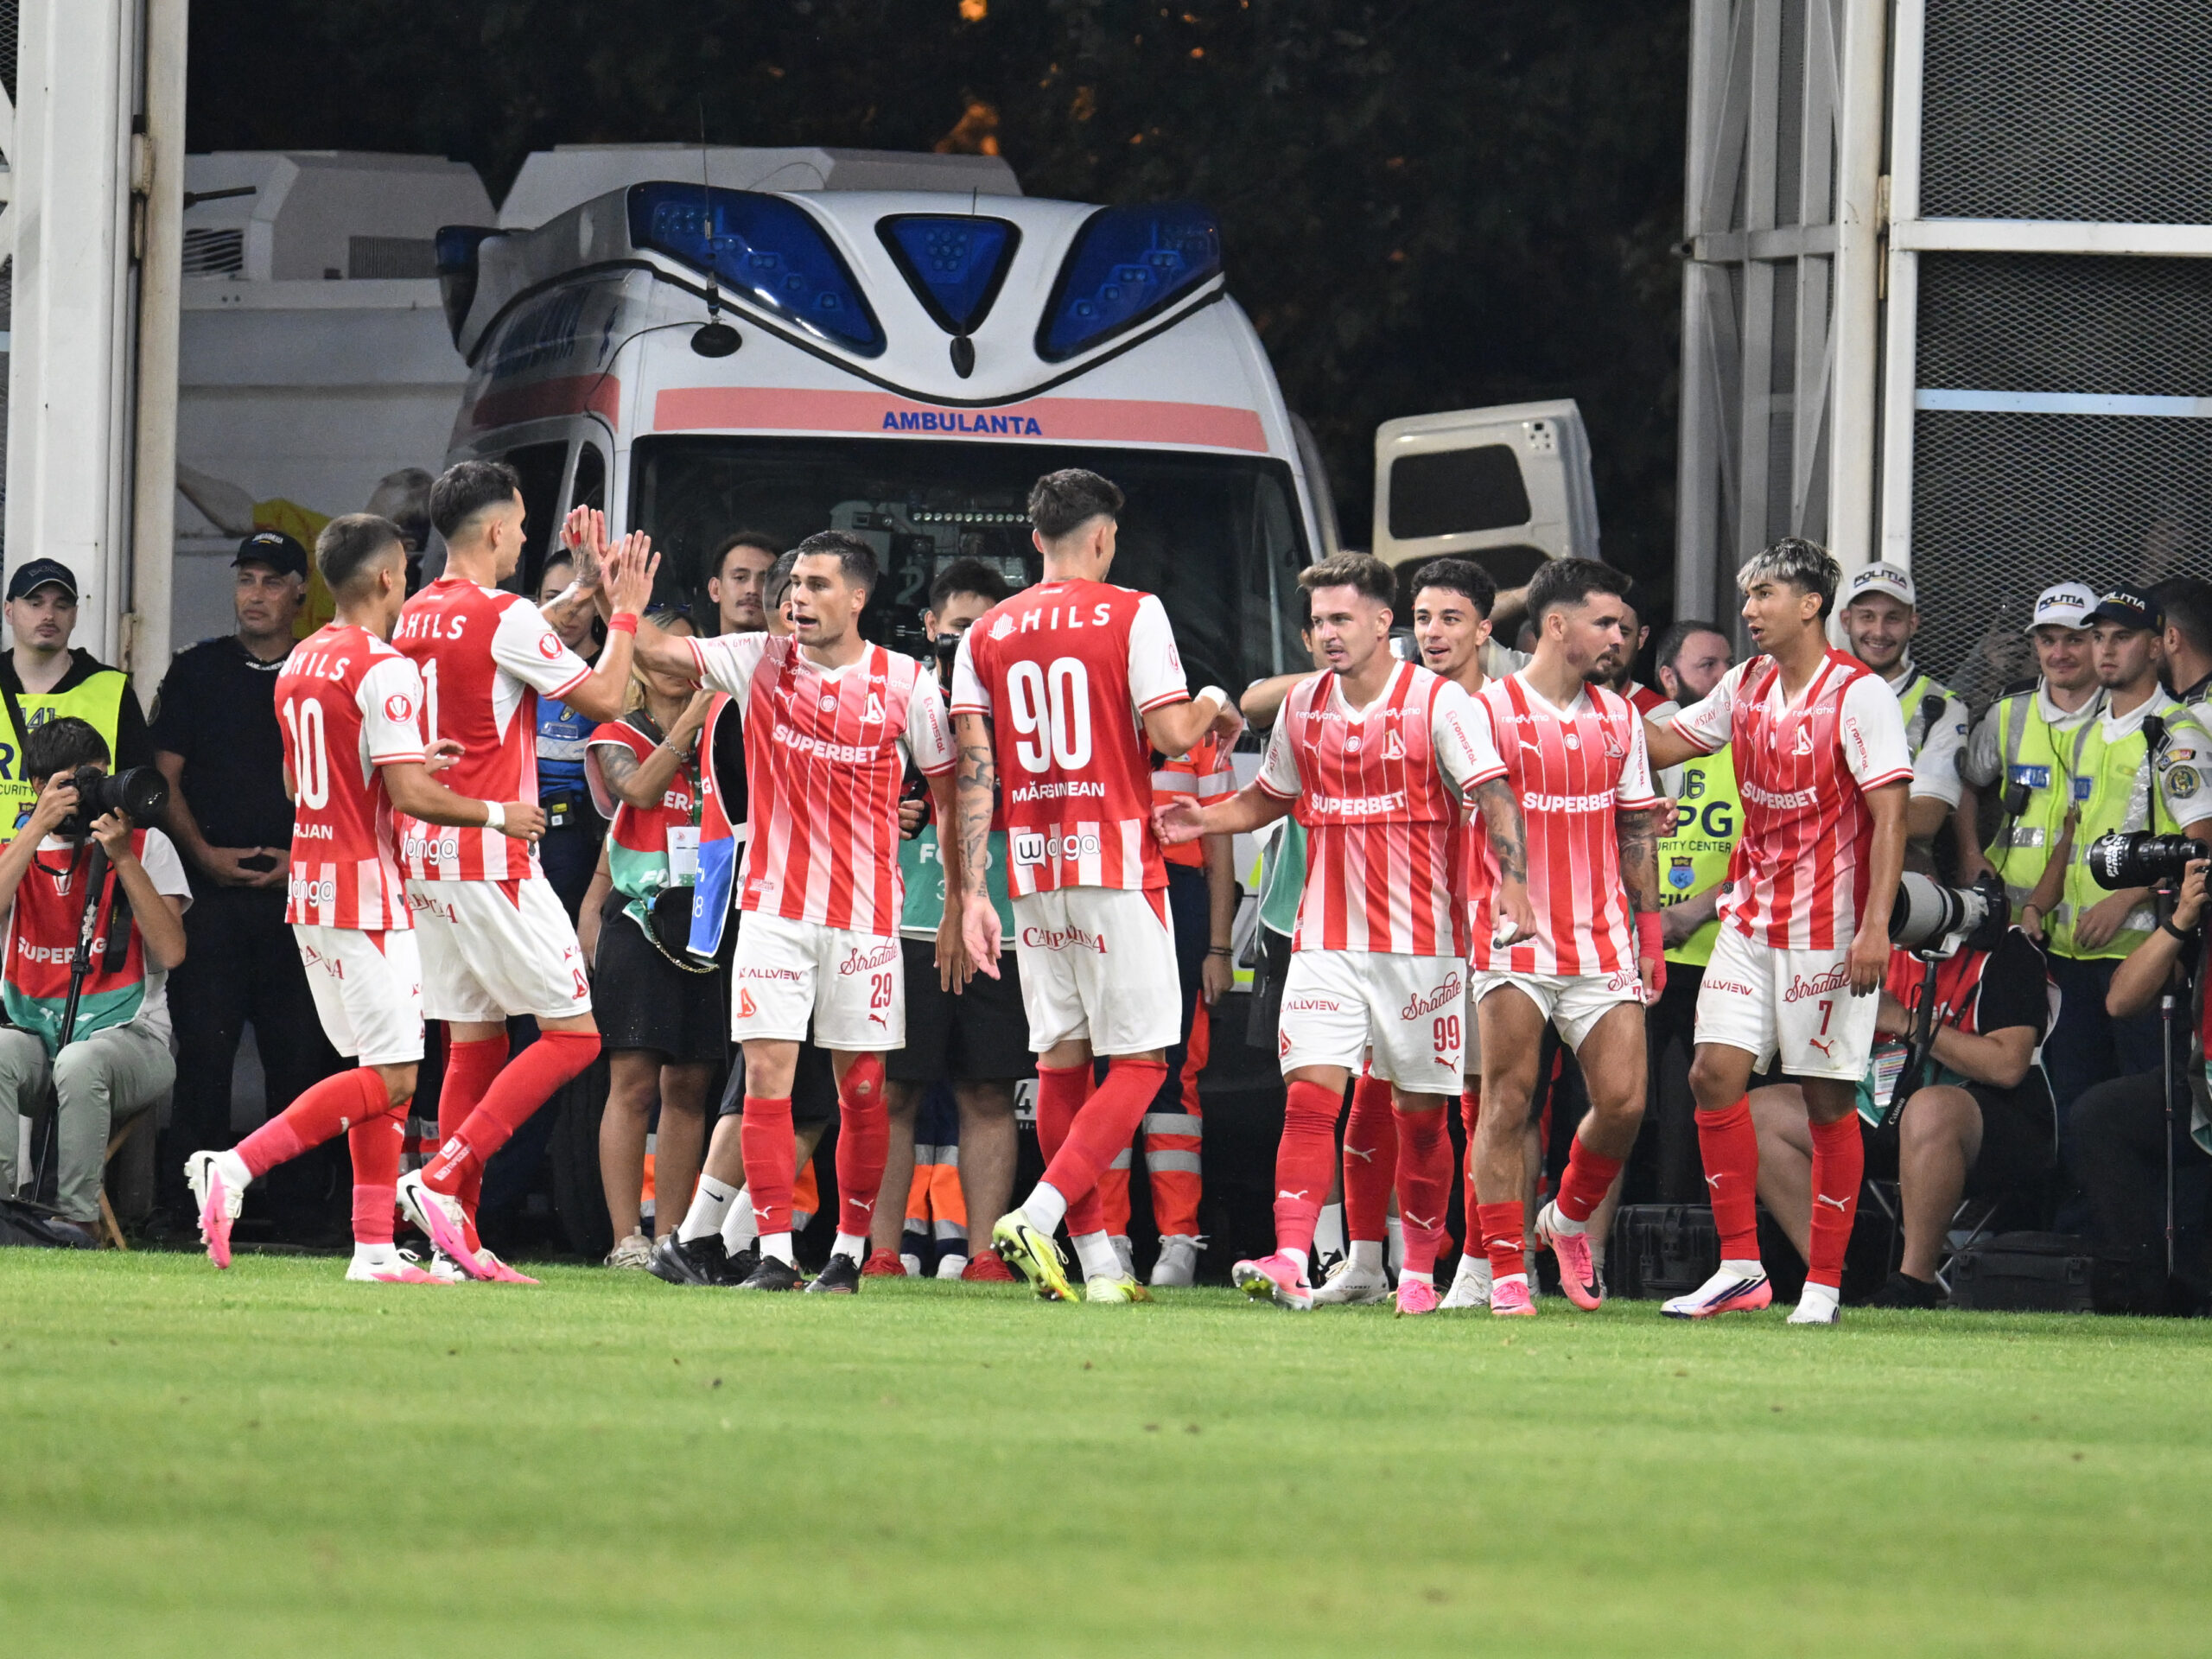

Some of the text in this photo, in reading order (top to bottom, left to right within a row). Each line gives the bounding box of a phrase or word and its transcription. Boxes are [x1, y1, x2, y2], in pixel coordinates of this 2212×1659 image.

[882, 411, 1042, 435] AMBULANTA
[405, 613, 467, 639] HILS
[1020, 604, 1111, 633] HILS
[291, 652, 351, 681] HILS
[1007, 657, 1091, 773] 90
[772, 724, 880, 763] SUPERBET
[928, 709, 946, 754] romstal
[1452, 721, 1478, 766] romstal
[283, 696, 329, 810] 10
[1312, 791, 1405, 816] SUPERBET
[1523, 788, 1615, 813] SUPERBET
[1741, 781, 1818, 810] SUPERBET
[1688, 841, 1732, 854] CENTER
[837, 938, 898, 976] Stradale
[748, 969, 803, 981] ALLVIEW
[1701, 979, 1754, 996] ALLVIEW
[870, 972, 893, 1009] 29
[1400, 971, 1463, 1020] Stradale
[1286, 1000, 1339, 1011] ALLVIEW
[1818, 1000, 1834, 1036] 7
[1433, 1014, 1461, 1052] 99
[1888, 1097, 1906, 1126] Canon
